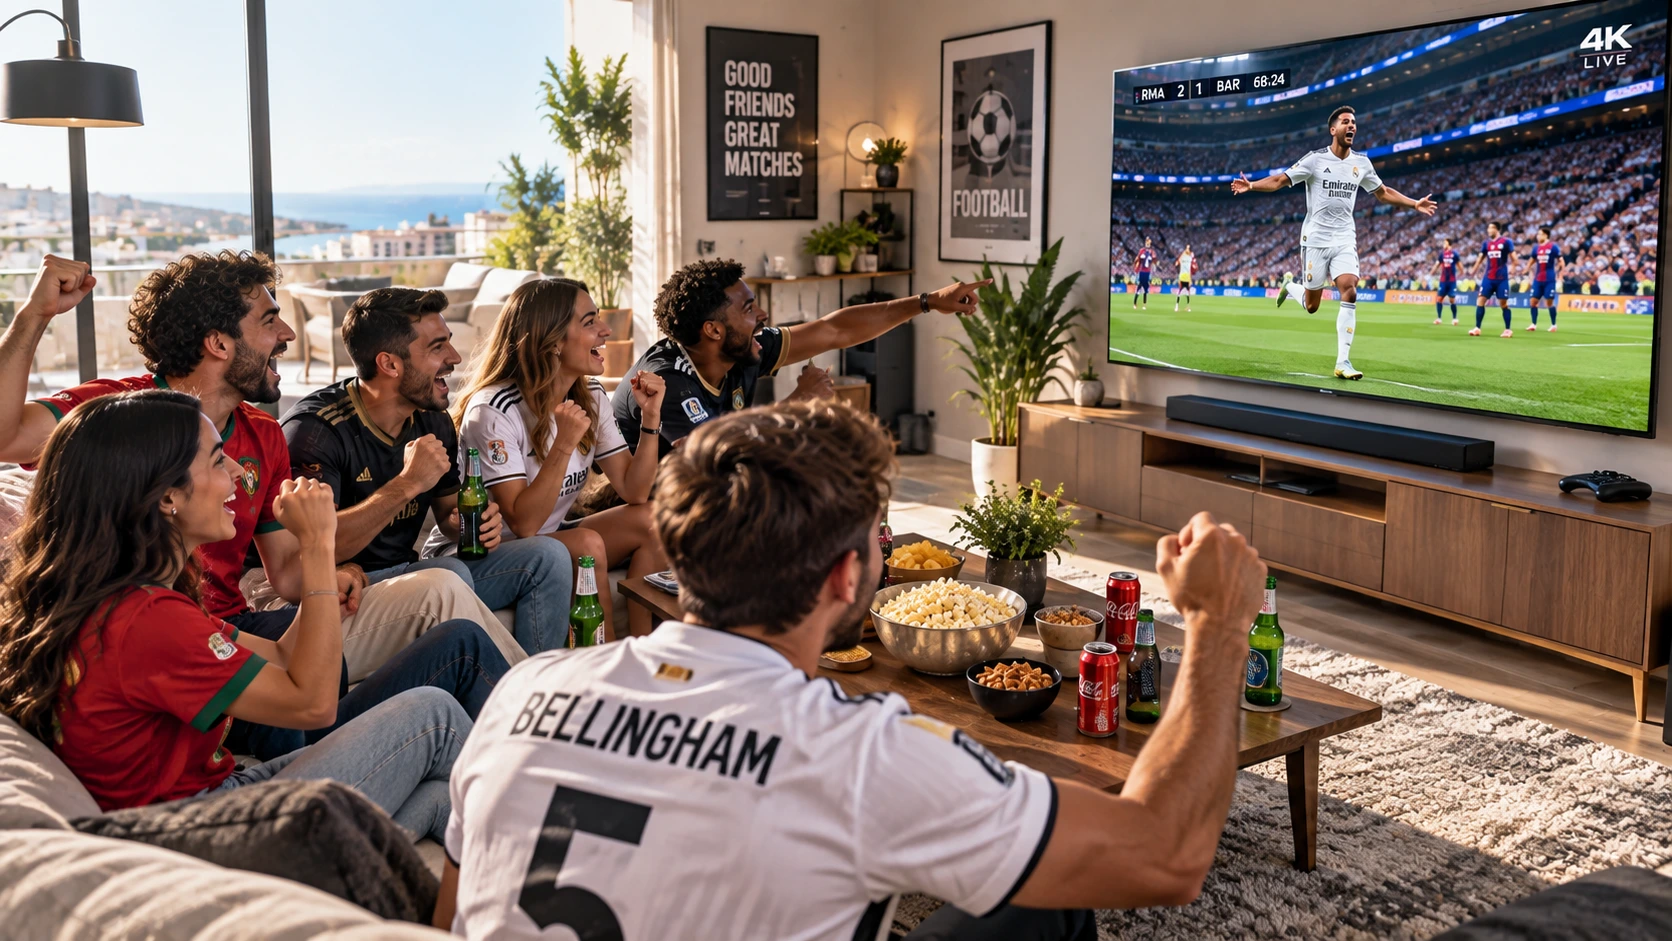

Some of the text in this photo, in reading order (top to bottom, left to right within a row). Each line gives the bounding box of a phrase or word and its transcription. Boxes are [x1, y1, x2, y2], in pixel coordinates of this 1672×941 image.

[1580, 24, 1632, 51] 4K
[725, 60, 771, 88] GOOD
[1584, 54, 1626, 69] LIVE
[1141, 87, 1165, 101] RMA
[1177, 84, 1185, 97] 2
[1195, 82, 1202, 95] 1
[1216, 78, 1240, 92] BAR
[725, 90, 795, 118] FRIENDS
[725, 121, 780, 148] GREAT
[725, 151, 803, 177] MATCHES
[953, 188, 1028, 218] FOOTBALL
[509, 692, 782, 786] BELLINGHAM
[518, 784, 653, 941] 5
